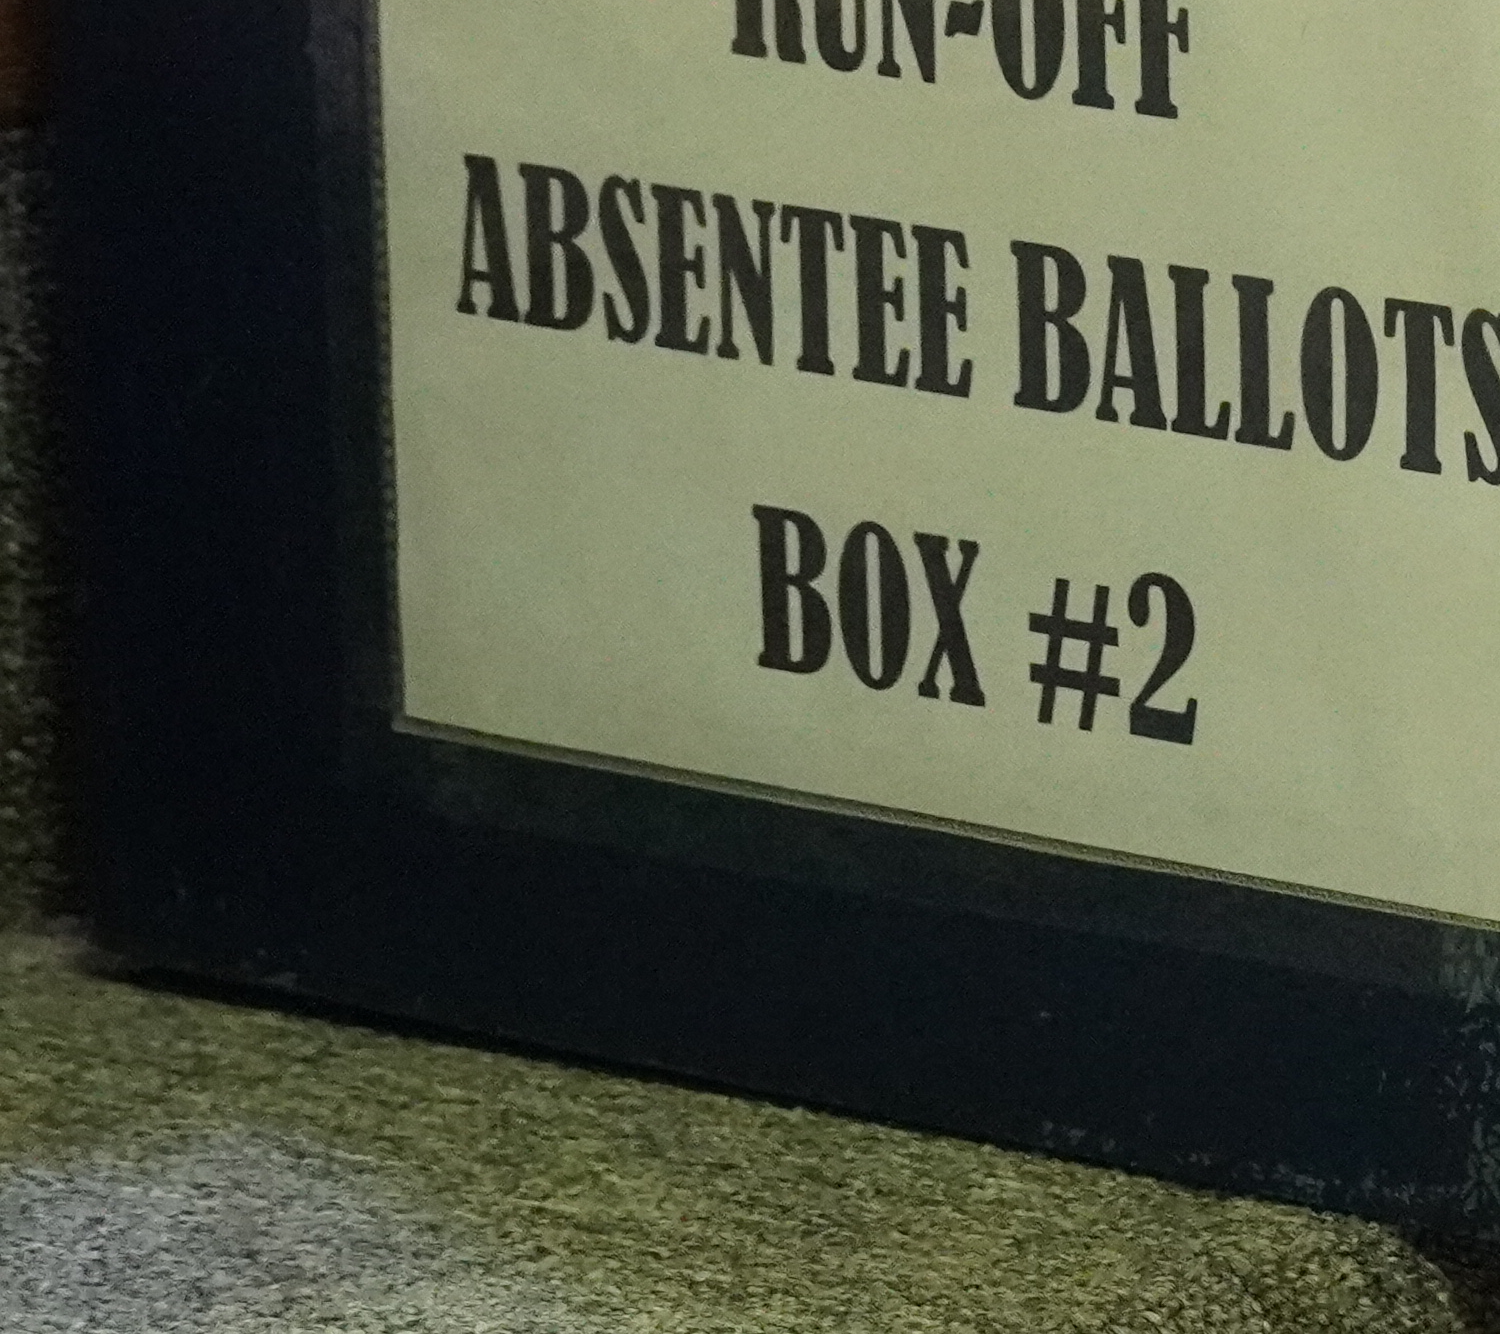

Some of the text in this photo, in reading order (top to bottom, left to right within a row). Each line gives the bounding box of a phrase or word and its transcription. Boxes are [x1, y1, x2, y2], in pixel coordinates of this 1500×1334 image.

[456, 153, 973, 399] ABSENTEE
[752, 504, 1198, 746] BOX #2
